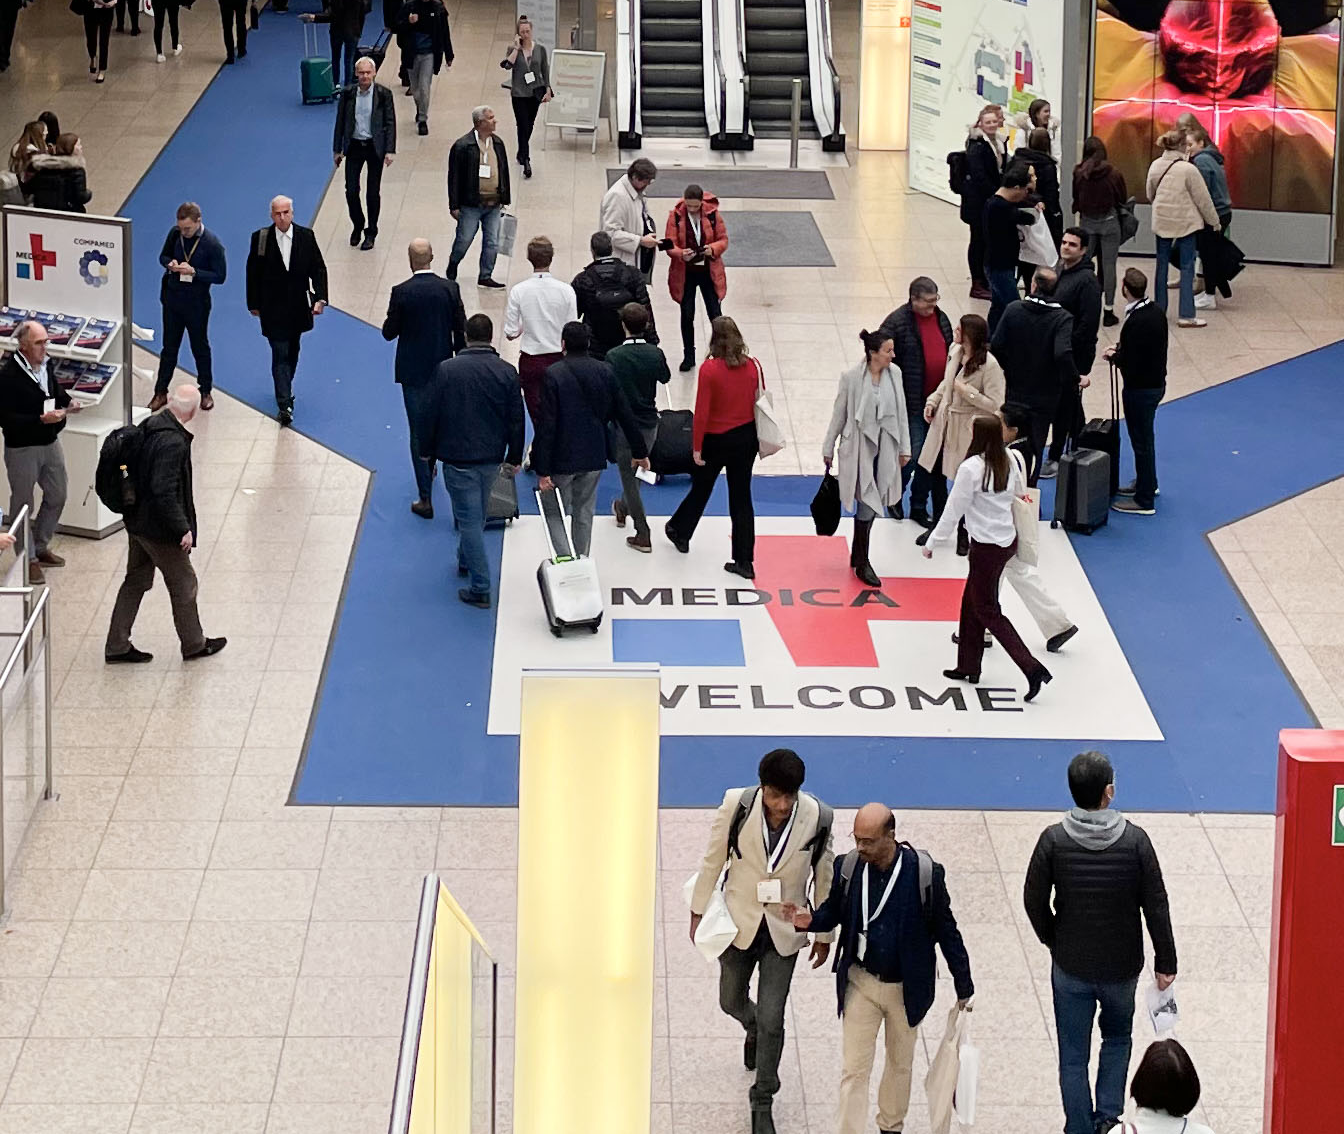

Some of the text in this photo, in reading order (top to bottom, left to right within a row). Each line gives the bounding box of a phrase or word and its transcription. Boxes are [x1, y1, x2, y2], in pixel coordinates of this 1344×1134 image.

[73, 237, 115, 249] COMPAMED
[16, 251, 48, 261] MEDICA
[611, 587, 902, 609] MEDICA
